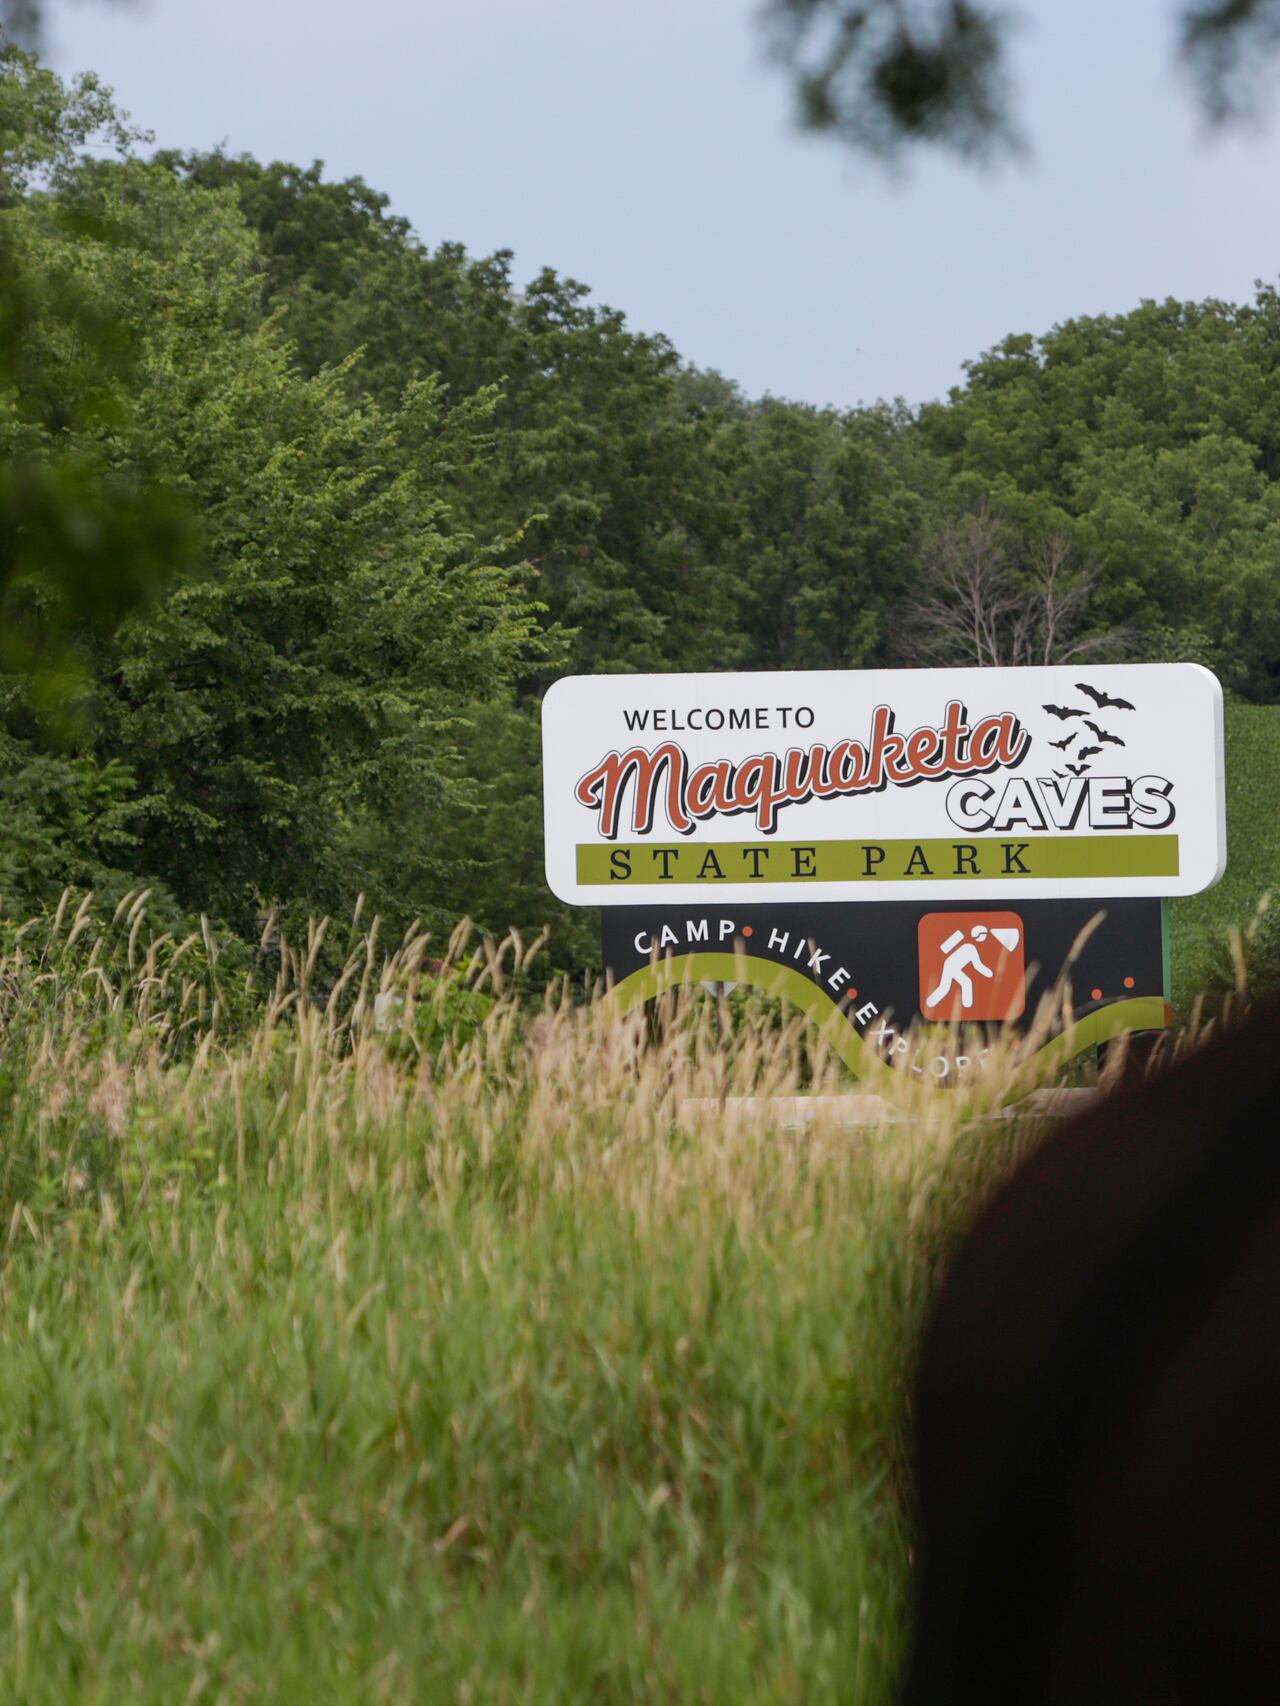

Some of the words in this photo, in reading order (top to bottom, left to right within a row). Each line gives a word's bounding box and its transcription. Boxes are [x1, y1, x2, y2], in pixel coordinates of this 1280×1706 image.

[623, 709, 769, 732] WELCOME
[777, 706, 815, 729] TO
[574, 700, 1032, 839] Maquoketa
[945, 775, 1177, 831] CAVES
[610, 847, 817, 880] STATE
[863, 843, 1032, 877] PARK
[634, 919, 735, 954] CAMP
[767, 927, 851, 991] HIKE
